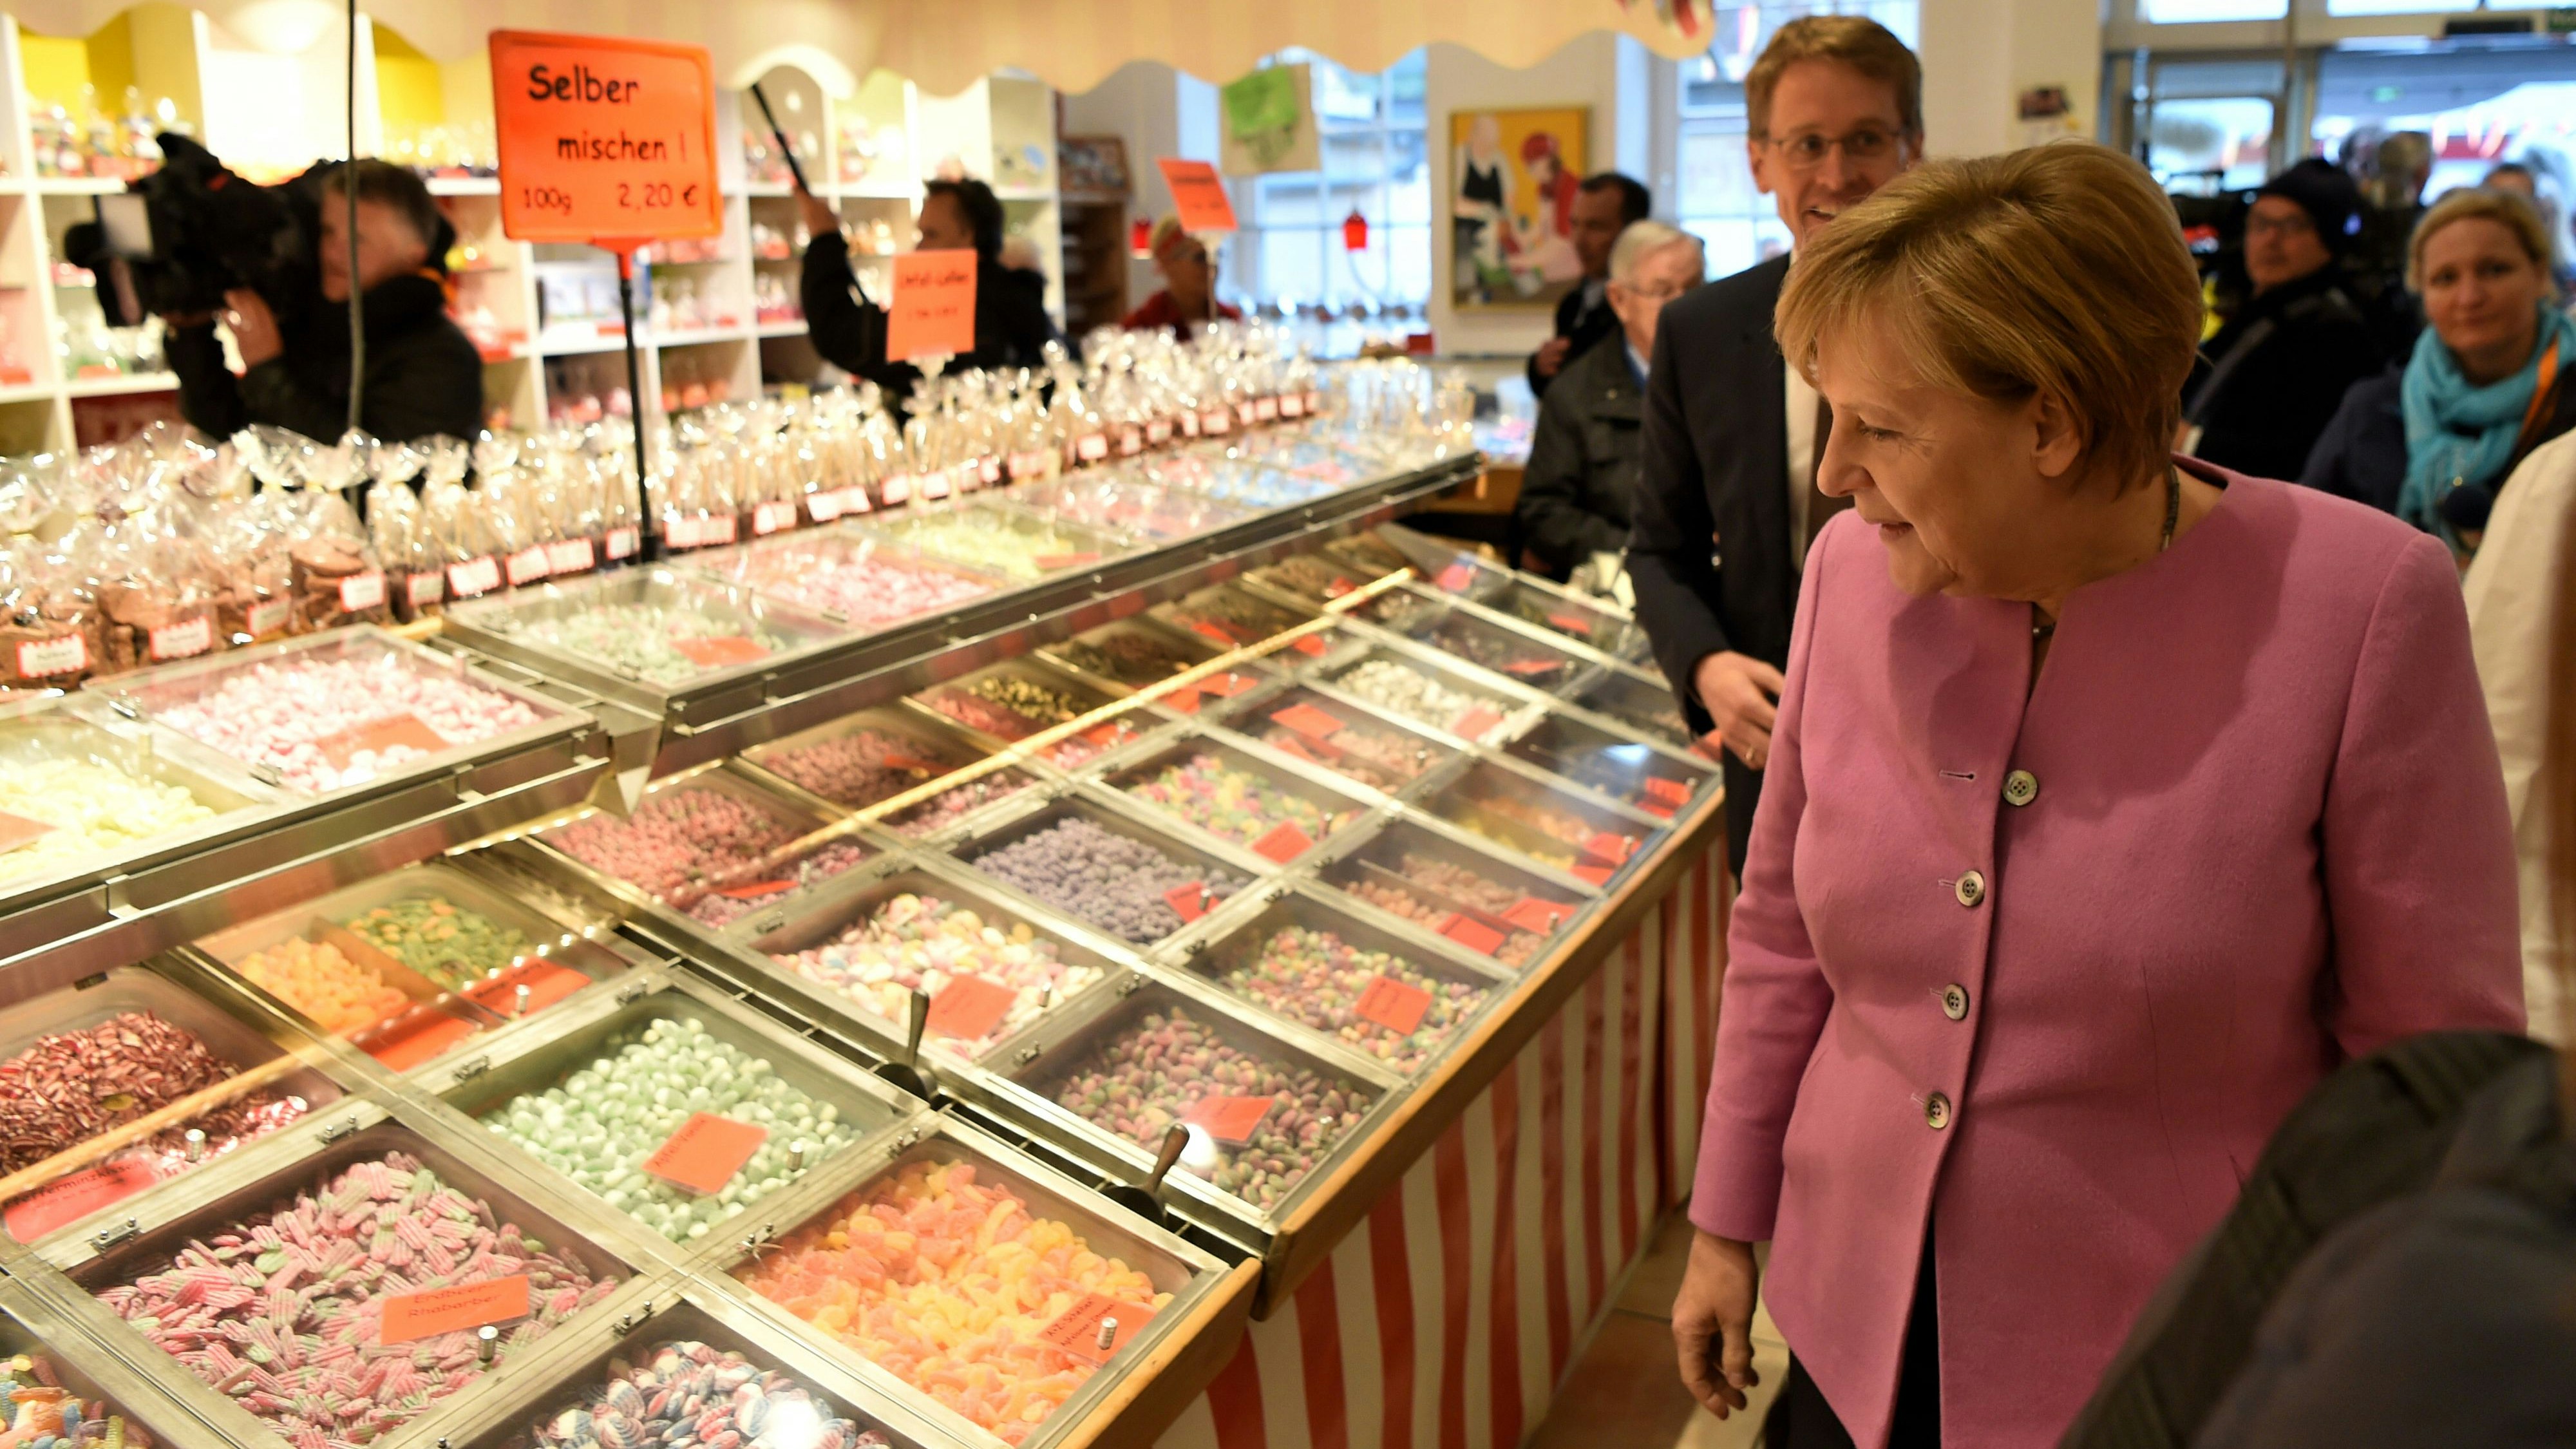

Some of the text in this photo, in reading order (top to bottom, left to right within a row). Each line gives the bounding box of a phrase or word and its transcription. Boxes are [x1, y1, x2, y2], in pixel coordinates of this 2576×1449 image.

[527, 64, 639, 104] Selber
[558, 129, 667, 161] mischen
[522, 183, 699, 216] 100g 2,20 €
[409, 1294, 499, 1316] Rhabarber
